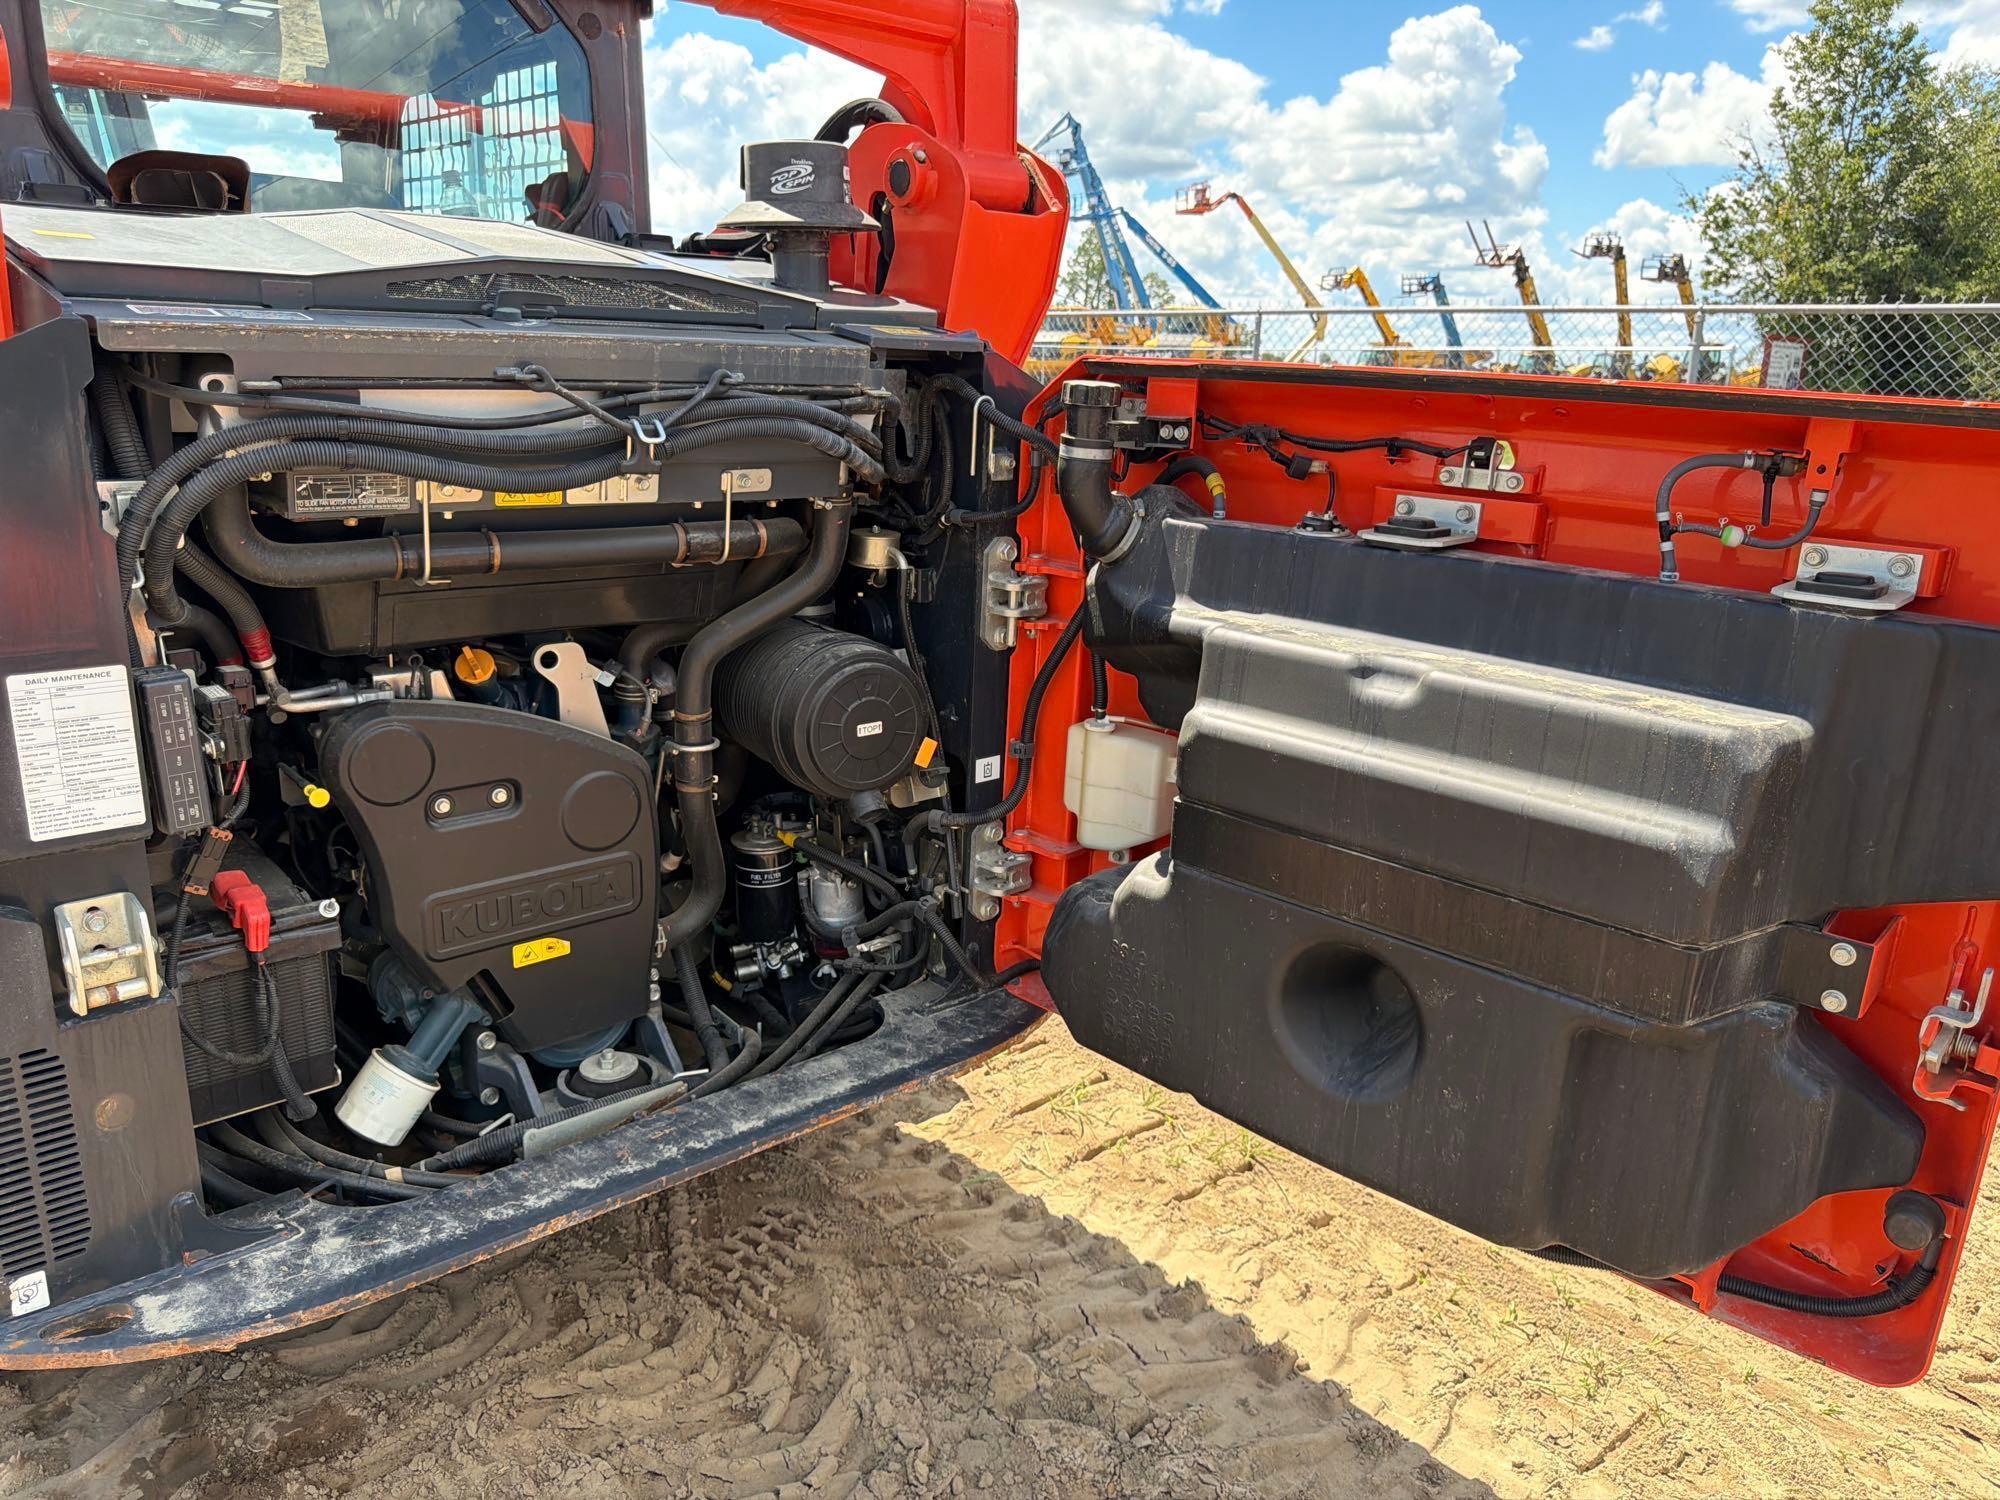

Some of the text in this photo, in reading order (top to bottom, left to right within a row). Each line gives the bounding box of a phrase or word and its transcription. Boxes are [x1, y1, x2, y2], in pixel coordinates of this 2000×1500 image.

[770, 170, 798, 184] TOP
[785, 174, 816, 189] SPIN
[305, 499, 318, 507] SLIDE
[330, 498, 346, 506] MOTOR
[377, 496, 408, 504] MAINTENANCE
[25, 671, 112, 686] DAILY MAINTENANCE
[863, 725, 878, 734] TOP
[764, 872, 781, 880] FILTER
[440, 871, 624, 944] KUBOTA
